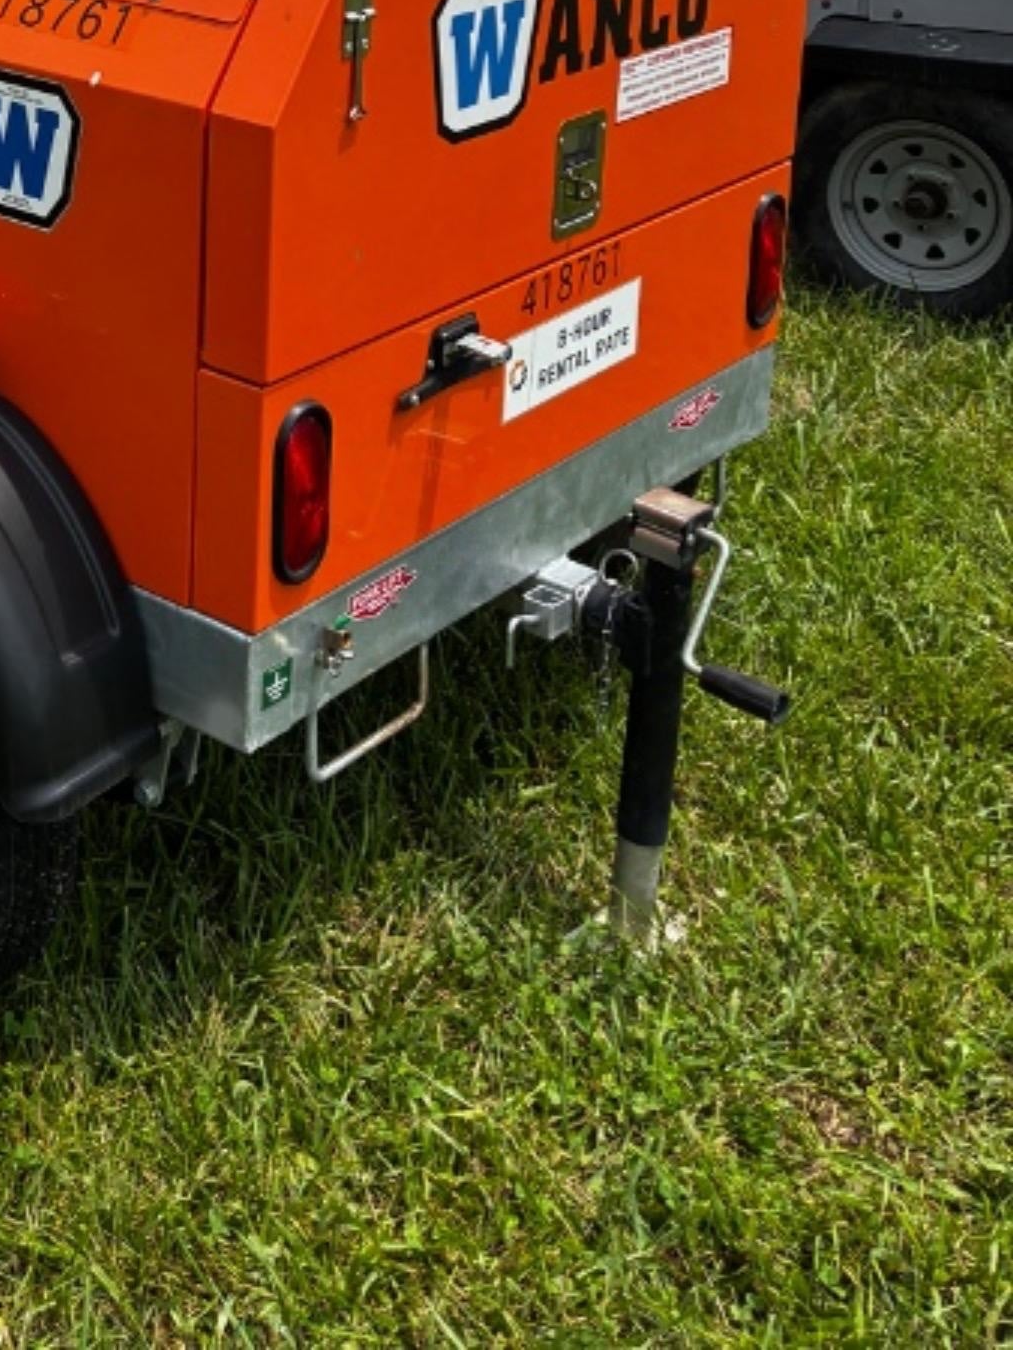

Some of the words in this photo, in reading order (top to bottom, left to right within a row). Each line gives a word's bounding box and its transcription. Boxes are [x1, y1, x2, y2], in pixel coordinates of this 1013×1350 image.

[520, 241, 622, 316] 418761
[538, 347, 591, 389] RENTAL
[595, 325, 631, 360] RATE
